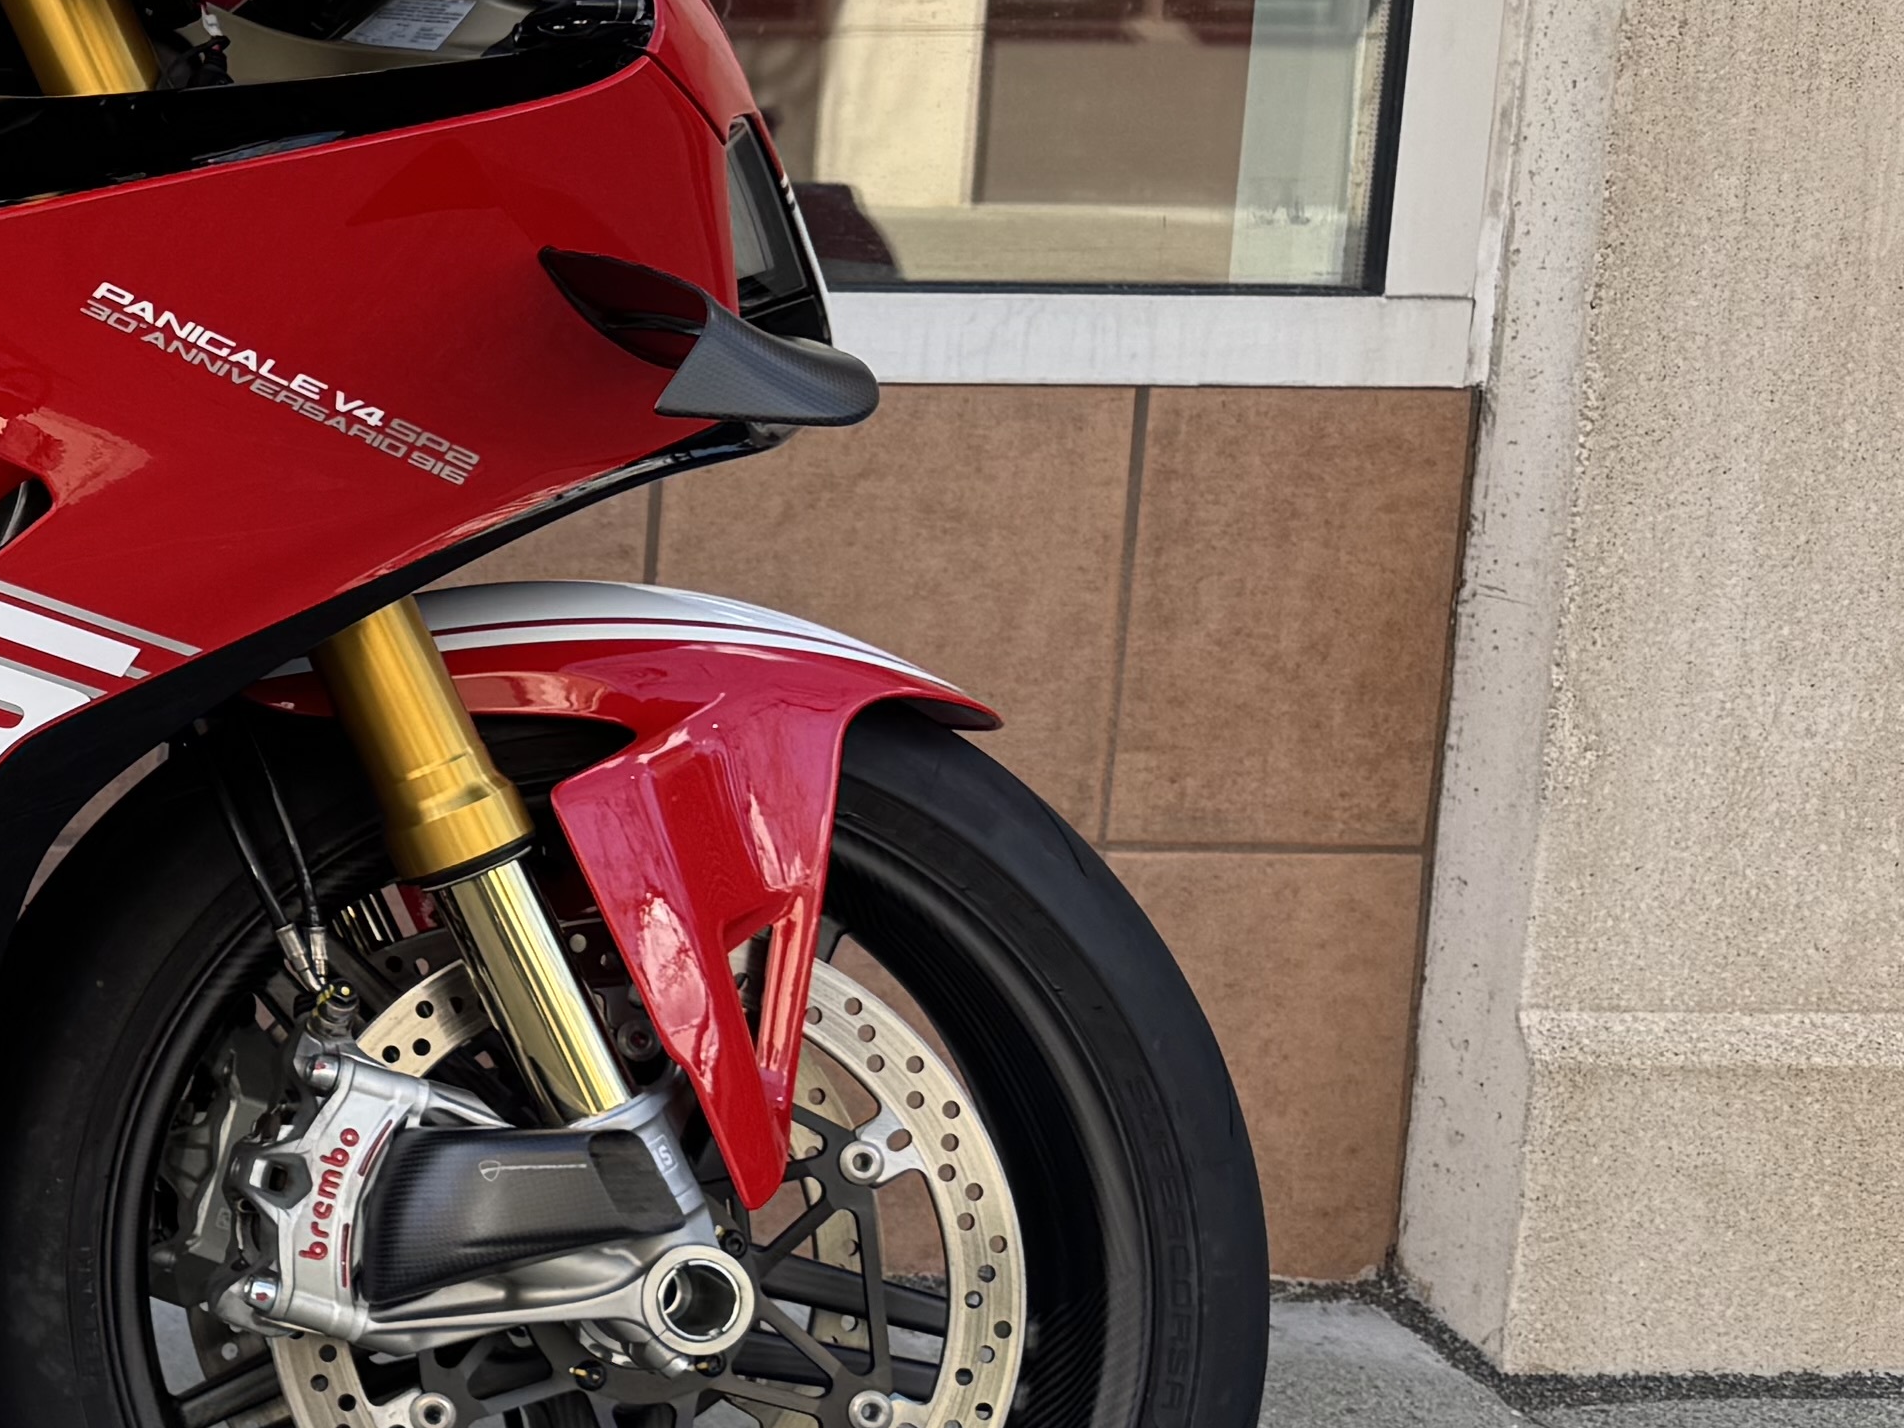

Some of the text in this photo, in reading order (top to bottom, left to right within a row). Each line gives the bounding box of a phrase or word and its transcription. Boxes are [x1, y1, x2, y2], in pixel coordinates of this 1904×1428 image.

[92, 282, 481, 472] PANIGALE V4 SP2
[141, 329, 408, 458] ANNIVERSARIO
[409, 450, 469, 486] 916
[298, 1127, 360, 1260] brembo
